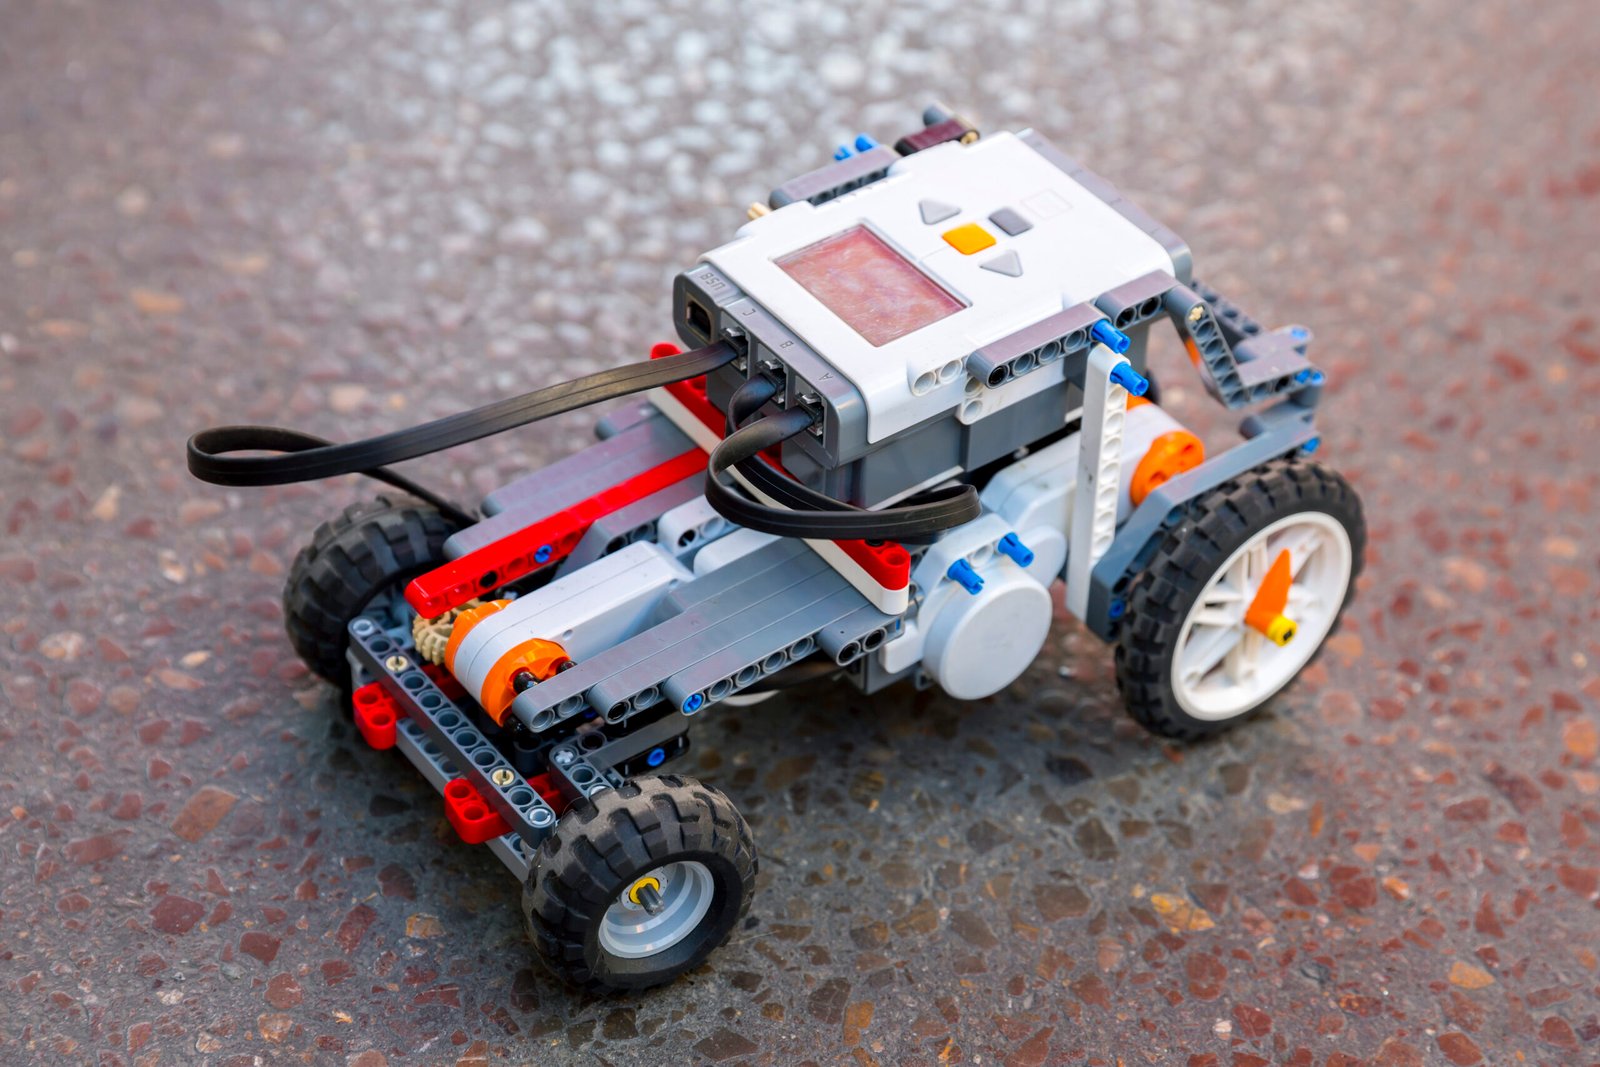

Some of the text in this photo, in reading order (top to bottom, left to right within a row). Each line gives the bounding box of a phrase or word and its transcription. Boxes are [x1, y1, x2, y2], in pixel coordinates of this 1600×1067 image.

[700, 272, 726, 290] USB
[742, 308, 757, 316] C
[780, 340, 794, 349] B
[818, 372, 834, 381] A
